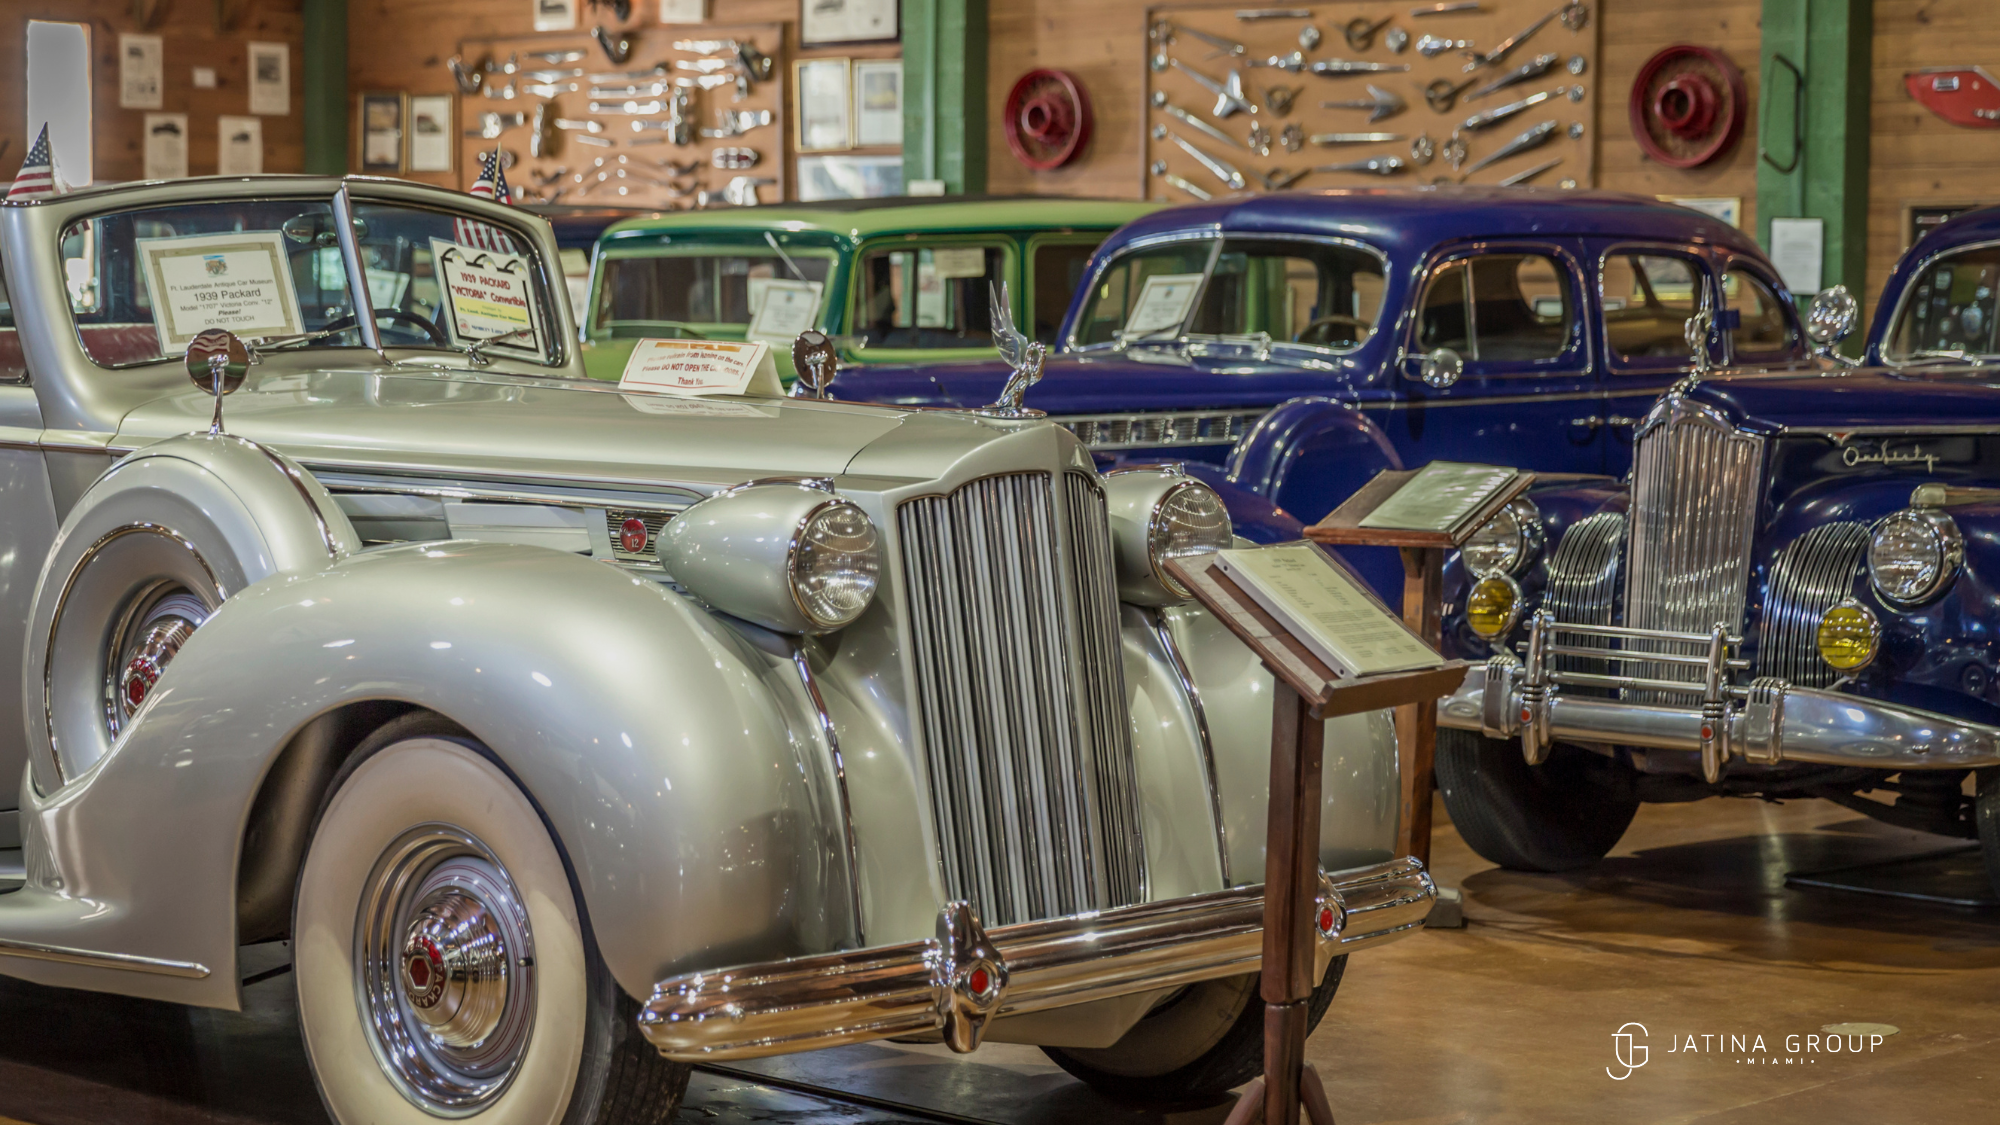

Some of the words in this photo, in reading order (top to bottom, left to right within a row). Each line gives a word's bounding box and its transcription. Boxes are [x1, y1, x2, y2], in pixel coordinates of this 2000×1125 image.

[180, 283, 213, 291] Lauderdale
[214, 281, 237, 289] Antique
[249, 278, 273, 286] Museum
[479, 275, 511, 290] PACKARD
[193, 291, 218, 302] 1939
[220, 287, 262, 300] Packard
[180, 304, 199, 312] Model
[220, 301, 243, 309] Victoria
[218, 308, 242, 316] Please!
[204, 318, 215, 326] DO
[231, 315, 255, 323] TOUCH
[725, 356, 734, 364] the
[661, 362, 671, 371] DO
[671, 362, 684, 371] NOT
[684, 363, 700, 372] OPEN
[677, 376, 695, 386] Thank
[409, 963, 443, 1007] PACKARD
